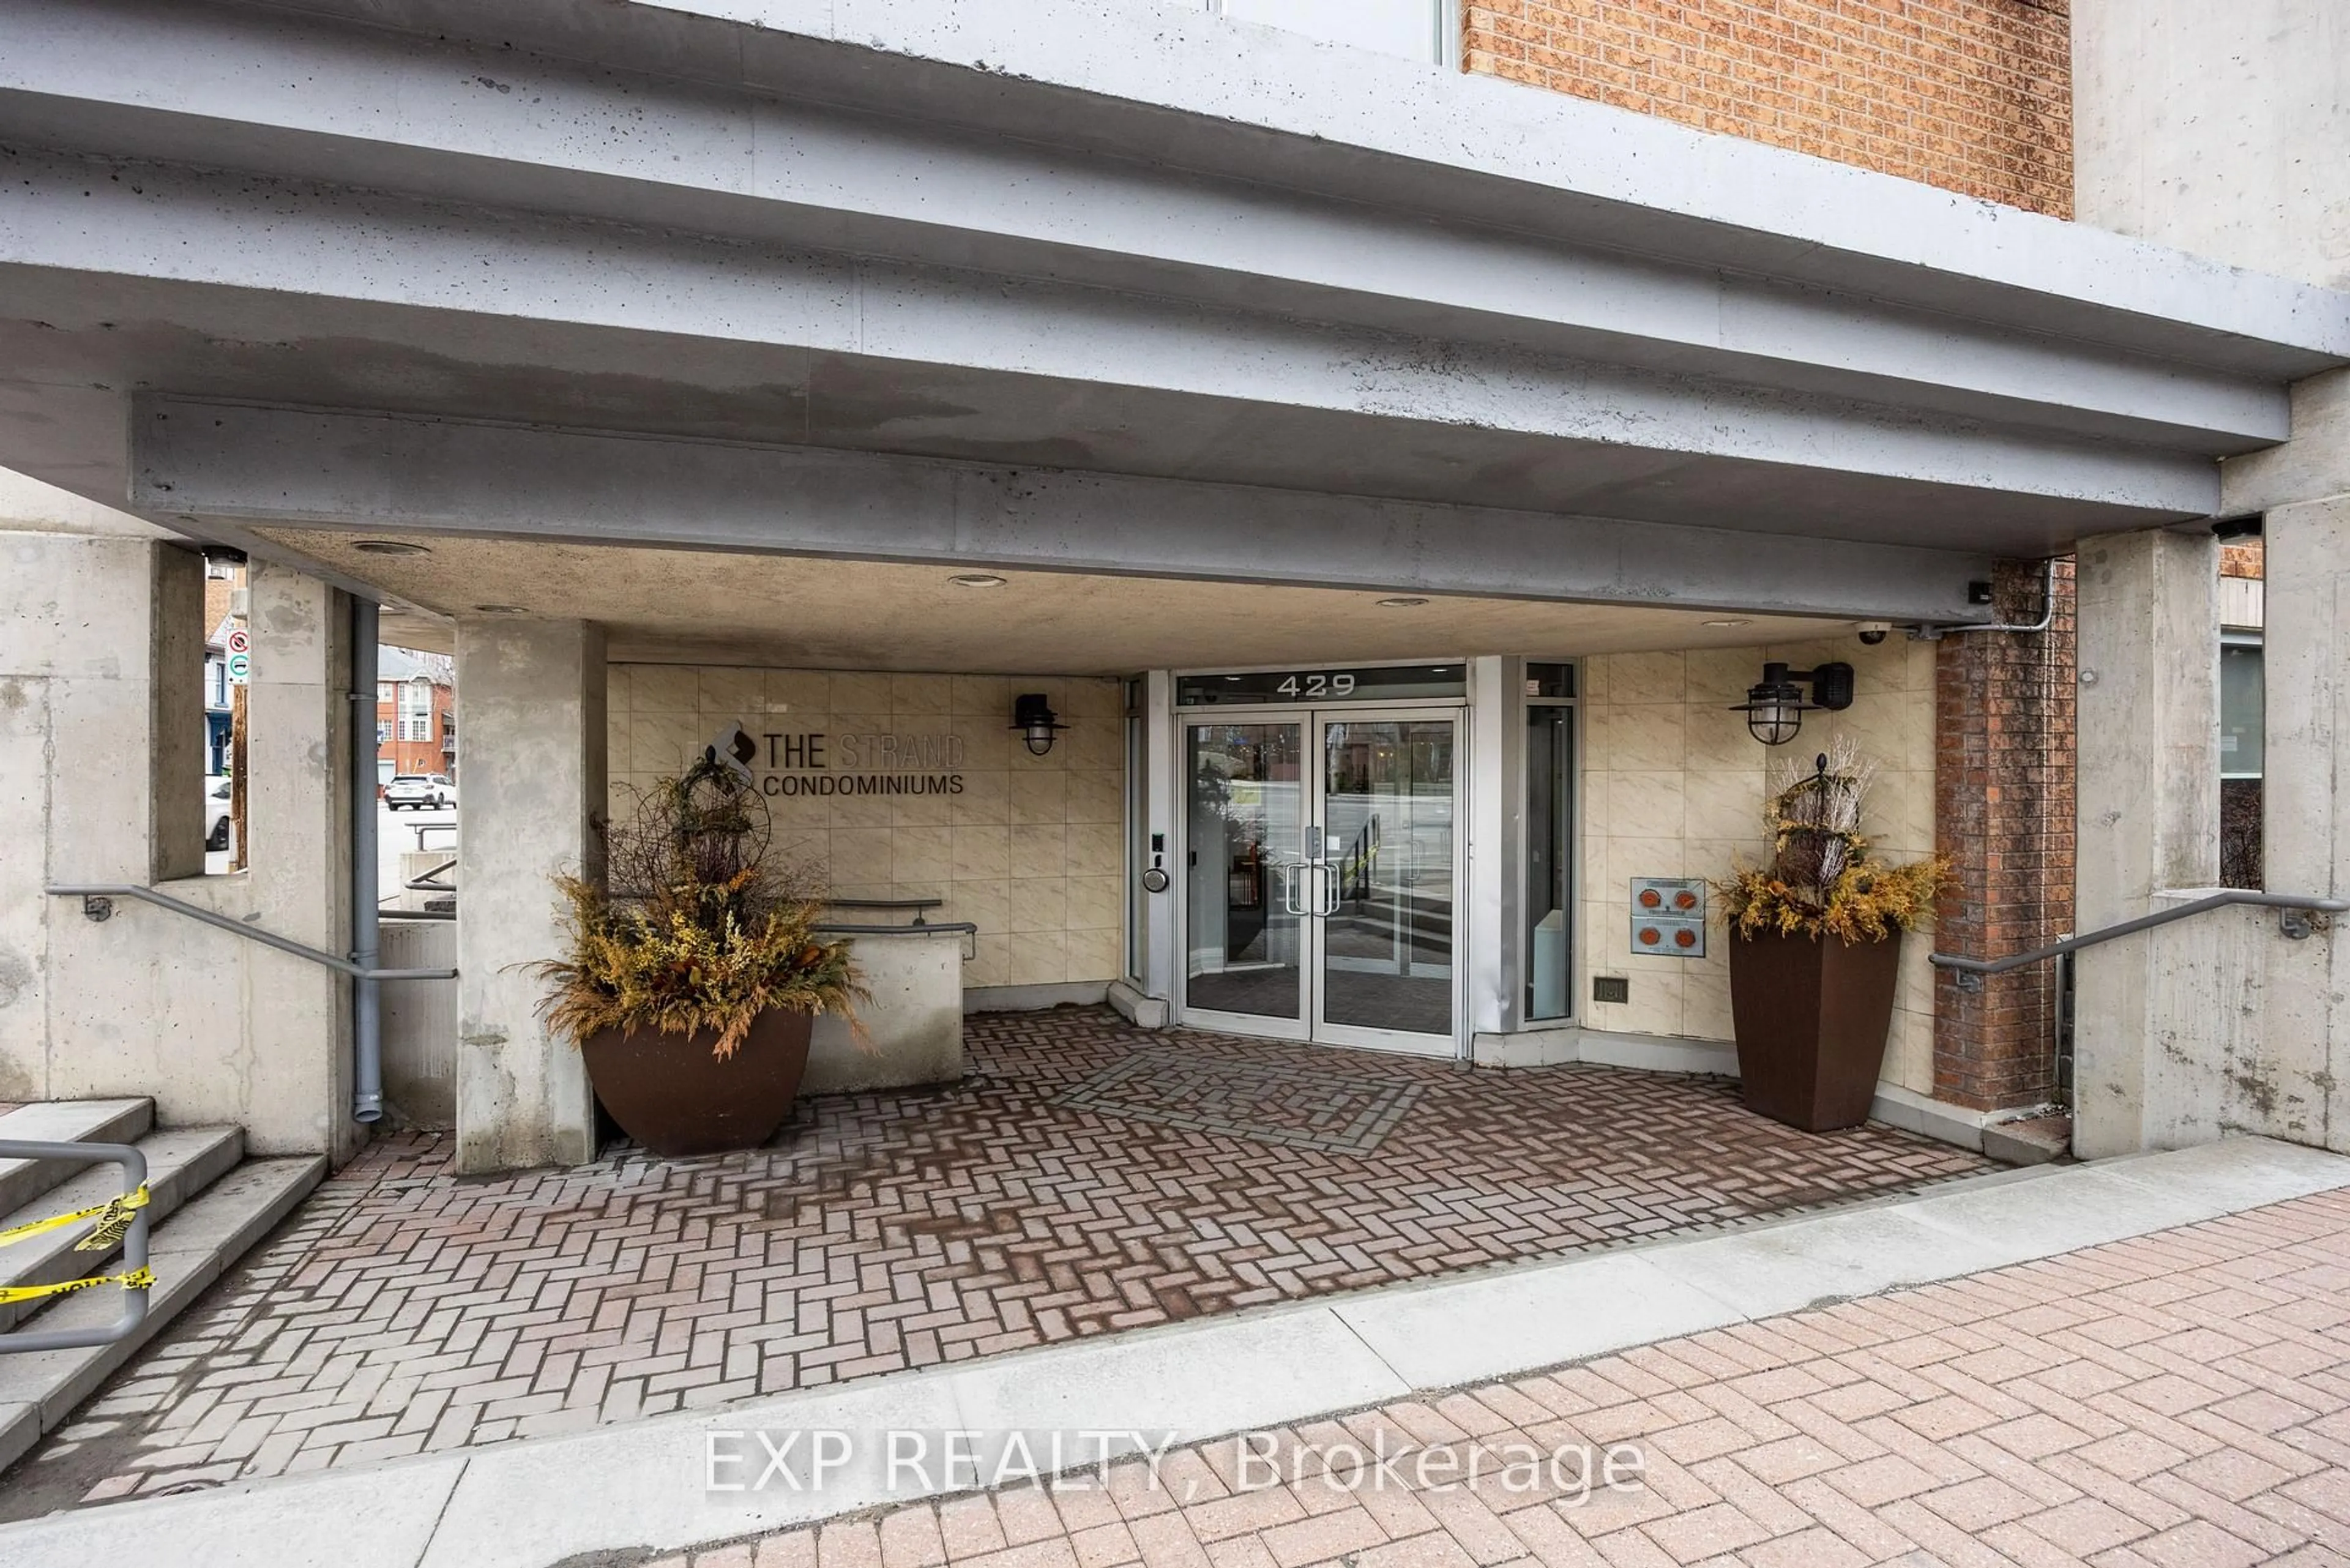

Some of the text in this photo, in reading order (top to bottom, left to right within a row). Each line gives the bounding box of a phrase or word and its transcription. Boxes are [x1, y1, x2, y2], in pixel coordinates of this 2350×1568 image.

[1277, 674, 1355, 696] 429
[763, 734, 964, 769] THE STRAND
[763, 774, 964, 796] CONDOMINIUMS
